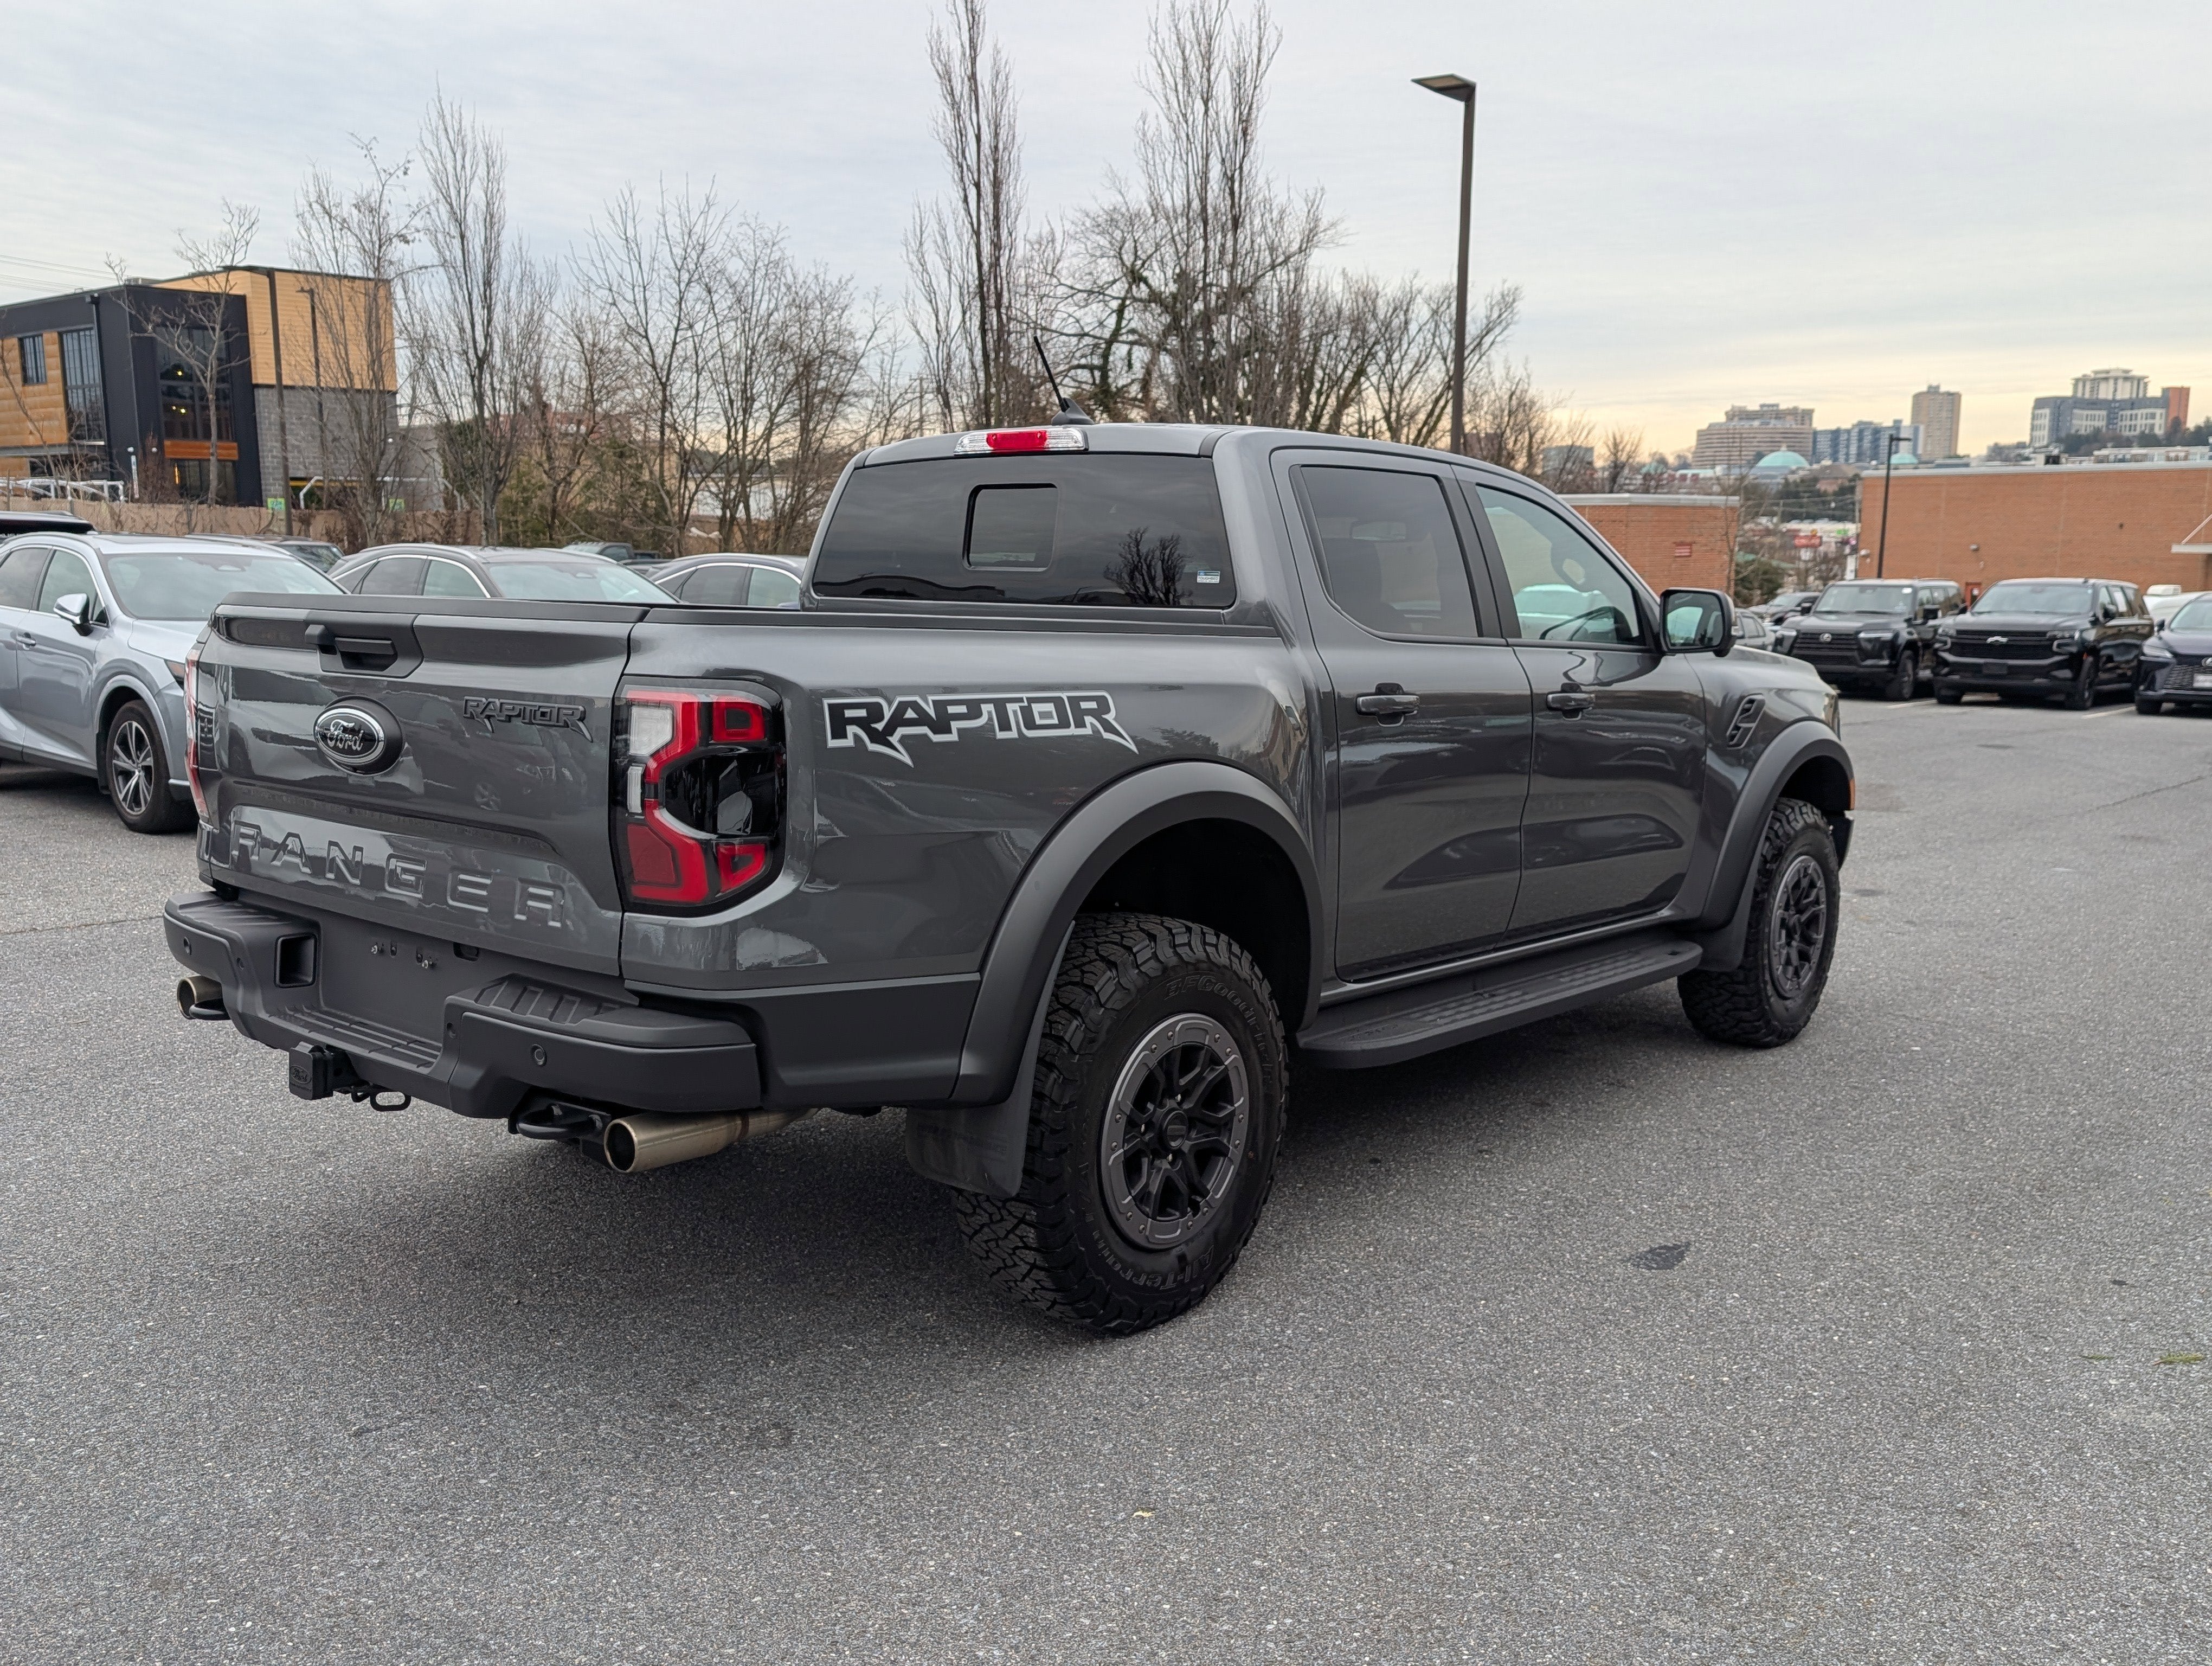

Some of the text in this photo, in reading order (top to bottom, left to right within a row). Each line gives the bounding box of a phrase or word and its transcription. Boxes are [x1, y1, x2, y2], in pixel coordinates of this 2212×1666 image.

[327, 719, 364, 751] Ford
[463, 696, 594, 743] RAPTOR
[822, 690, 1139, 768] RAPTOR
[230, 820, 566, 928] RANGER
